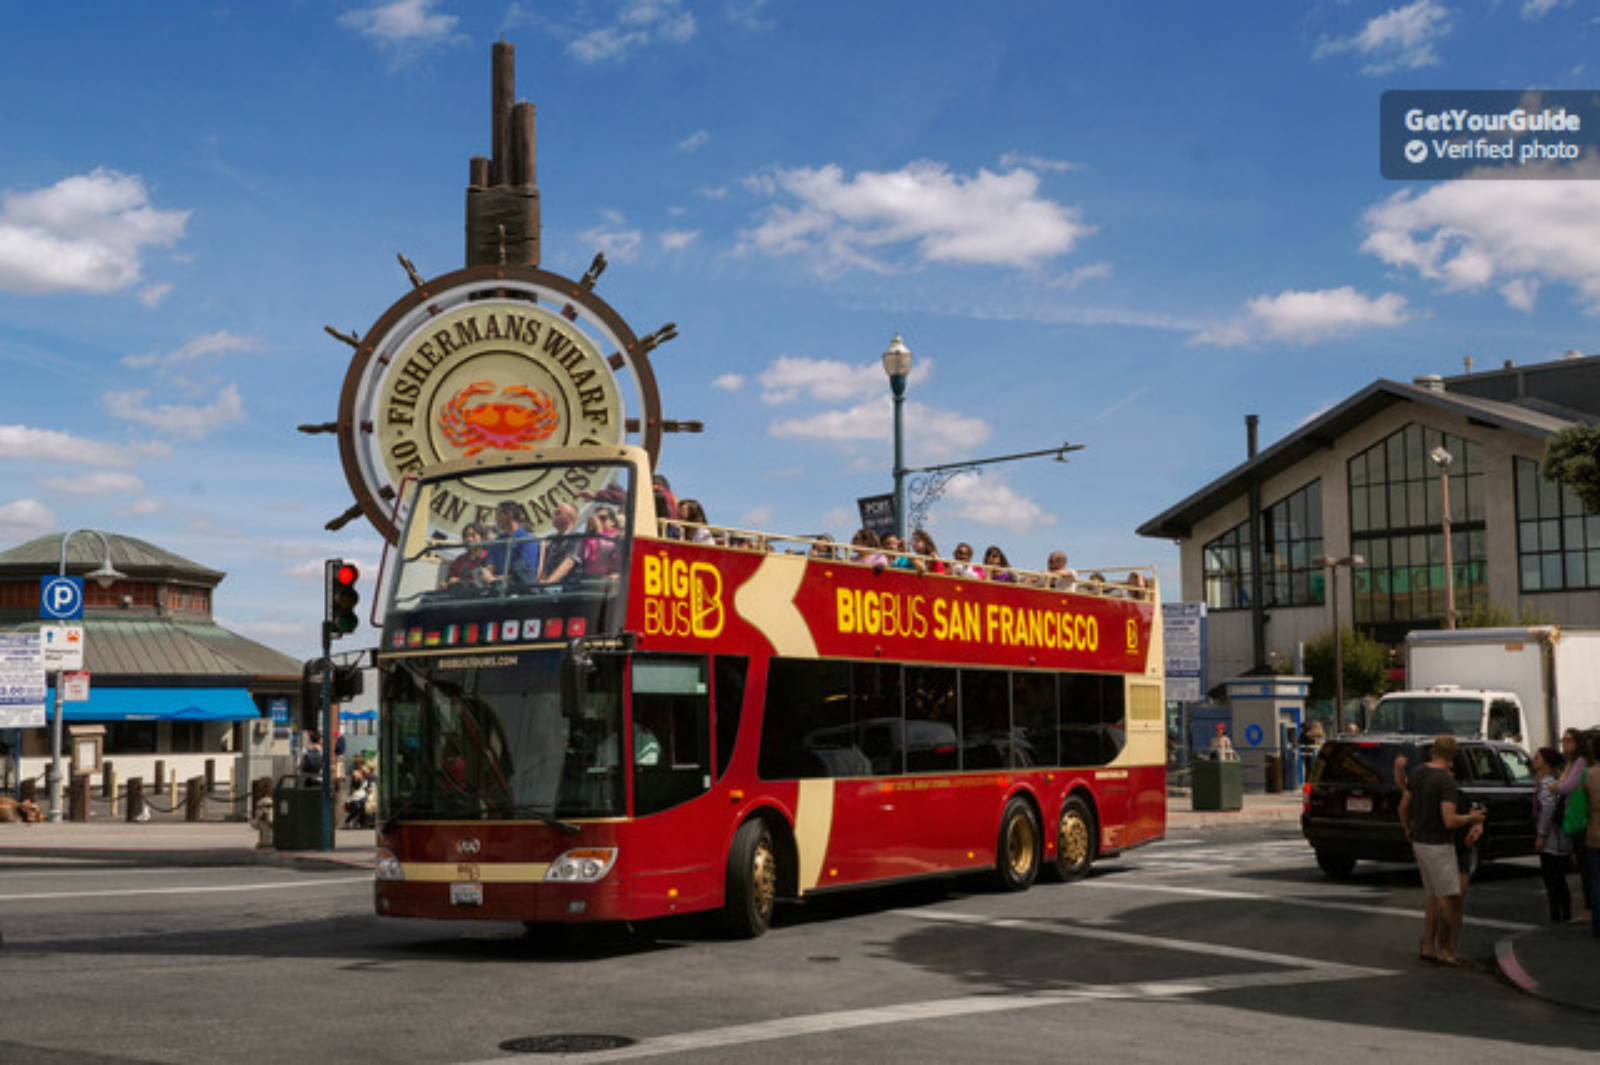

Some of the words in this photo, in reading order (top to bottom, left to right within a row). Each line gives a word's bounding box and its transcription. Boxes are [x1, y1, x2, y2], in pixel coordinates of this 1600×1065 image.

[387, 313, 541, 427] FISHERMANS
[543, 327, 609, 426] WHARF
[391, 439, 425, 474] OF
[644, 554, 688, 598] BIG
[54, 586, 73, 610] P
[644, 597, 691, 636] BUS
[933, 597, 981, 643] SAN
[986, 604, 1099, 652] FRANCISCO
